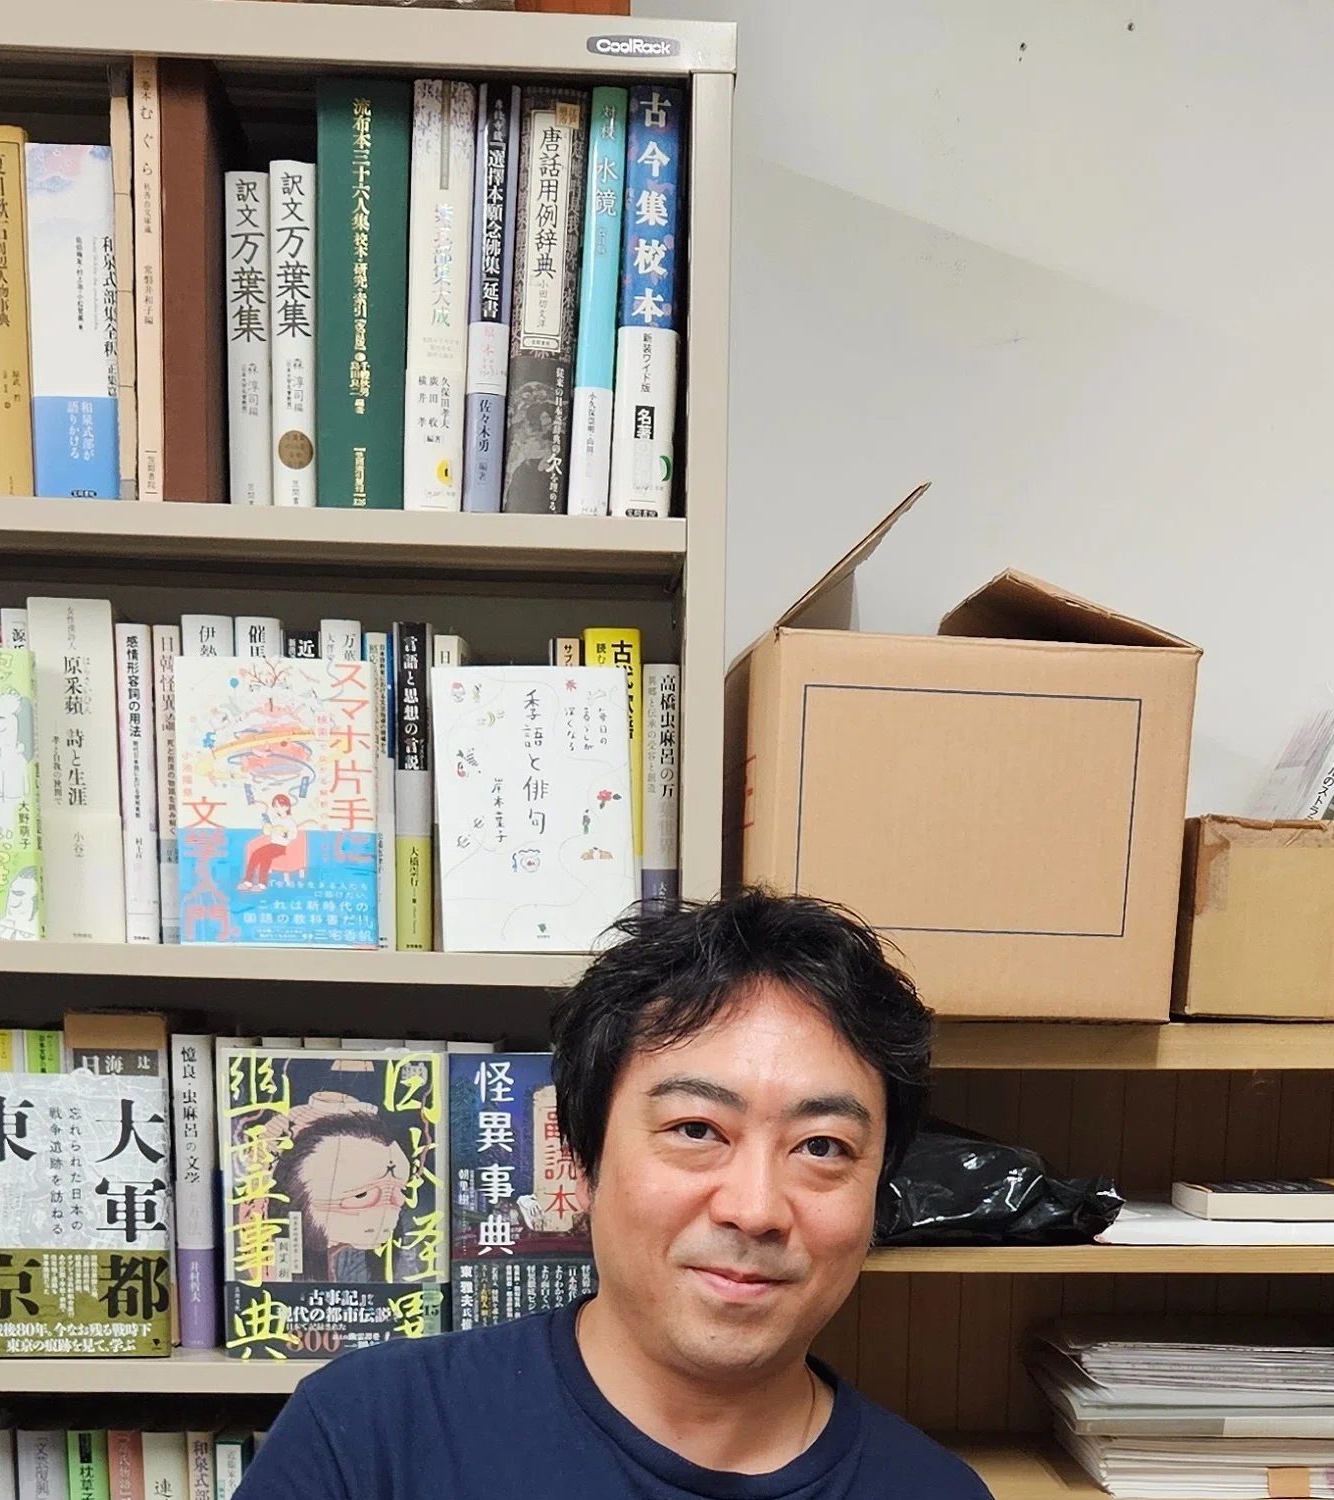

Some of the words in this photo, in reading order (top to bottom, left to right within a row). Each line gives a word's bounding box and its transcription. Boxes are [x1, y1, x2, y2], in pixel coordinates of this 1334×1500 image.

[596, 37, 672, 57] CoolRack
[138, 104, 155, 177] むぐら
[599, 105, 617, 141] 対校
[351, 97, 372, 232] 流布本三十六人集
[593, 156, 619, 218] 水鏡
[533, 127, 564, 280] 唐話用例辞典
[631, 93, 673, 324] 古今集校本
[230, 178, 267, 344] 訳文万葉集
[275, 171, 313, 340] 訳文万葉集
[536, 277, 549, 330] 小田切文洋
[639, 332, 653, 394] 新装ワイド版
[67, 401, 81, 460] 語りかける
[80, 400, 95, 462] 和泉式部が
[440, 375, 451, 431] 久保田孝夫
[477, 399, 492, 453] 佐々木勇
[297, 638, 316, 658] 近
[595, 642, 607, 665] 読む
[126, 636, 142, 738] 感情形容詞の用法
[402, 636, 420, 770] 言語と思想の言説
[328, 662, 375, 862] スマホ片手に
[522, 688, 551, 835] 季語と俳句
[563, 706, 576, 752] 深くなる
[598, 707, 609, 746] 毎日の
[66, 727, 88, 807] 詩と生涯
[18, 800, 32, 849] 大野萌子
[256, 900, 370, 913] これは新時代の
[179, 1045, 201, 1185] 憶良・虫麻呂の文学
[48, 1106, 63, 1236] 戦争遺跡を訪ねる
[67, 1106, 84, 1232] 忘れられた日本の
[473, 1059, 517, 1258] 怪異事典
[93, 1098, 169, 1320] 大軍都
